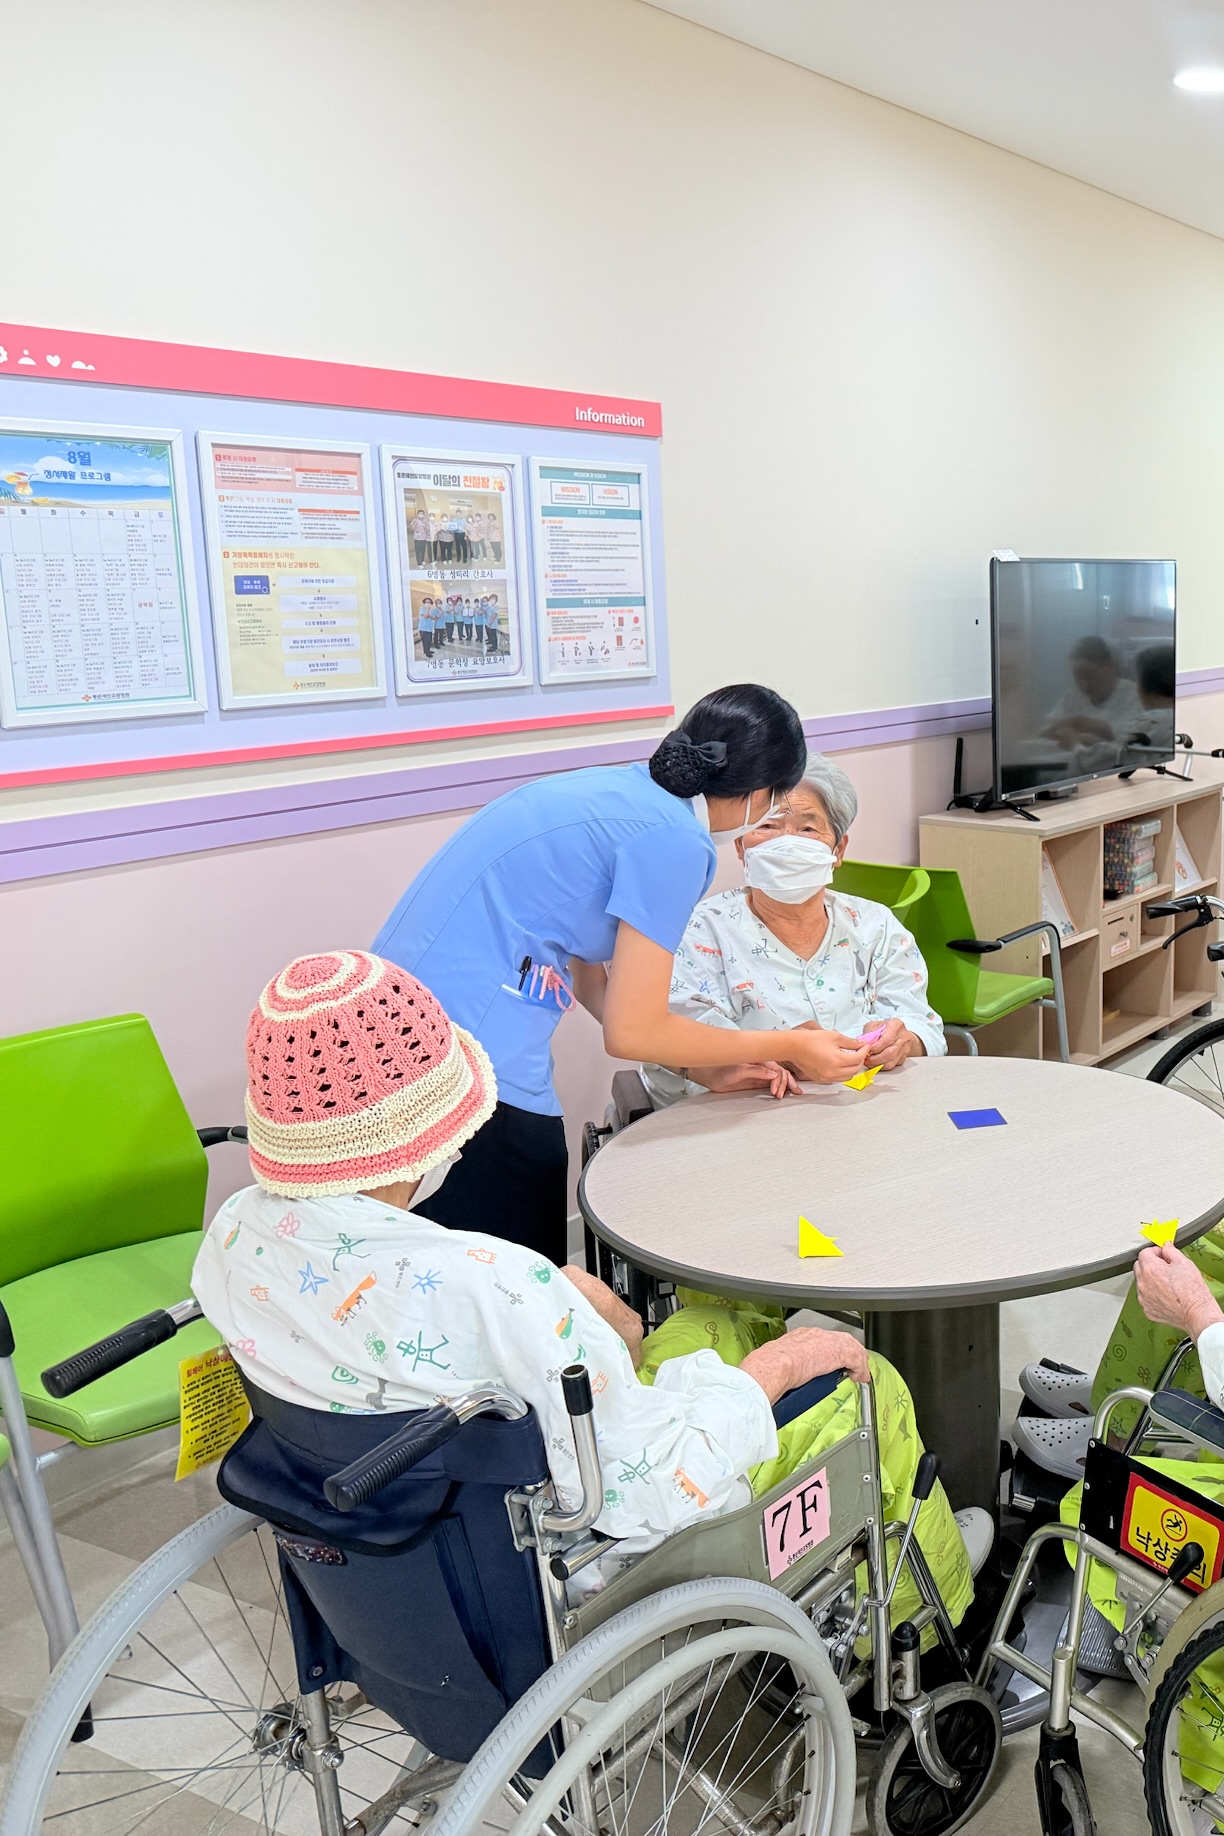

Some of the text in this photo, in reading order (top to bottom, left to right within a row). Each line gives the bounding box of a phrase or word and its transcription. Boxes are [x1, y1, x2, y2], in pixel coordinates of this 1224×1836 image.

[575, 407, 645, 427] Information
[67, 450, 92, 467] 8월
[80, 472, 112, 482] 프로그램
[433, 473, 461, 487] 이달의
[473, 569, 494, 579] 간호사
[771, 1479, 823, 1553] 7F
